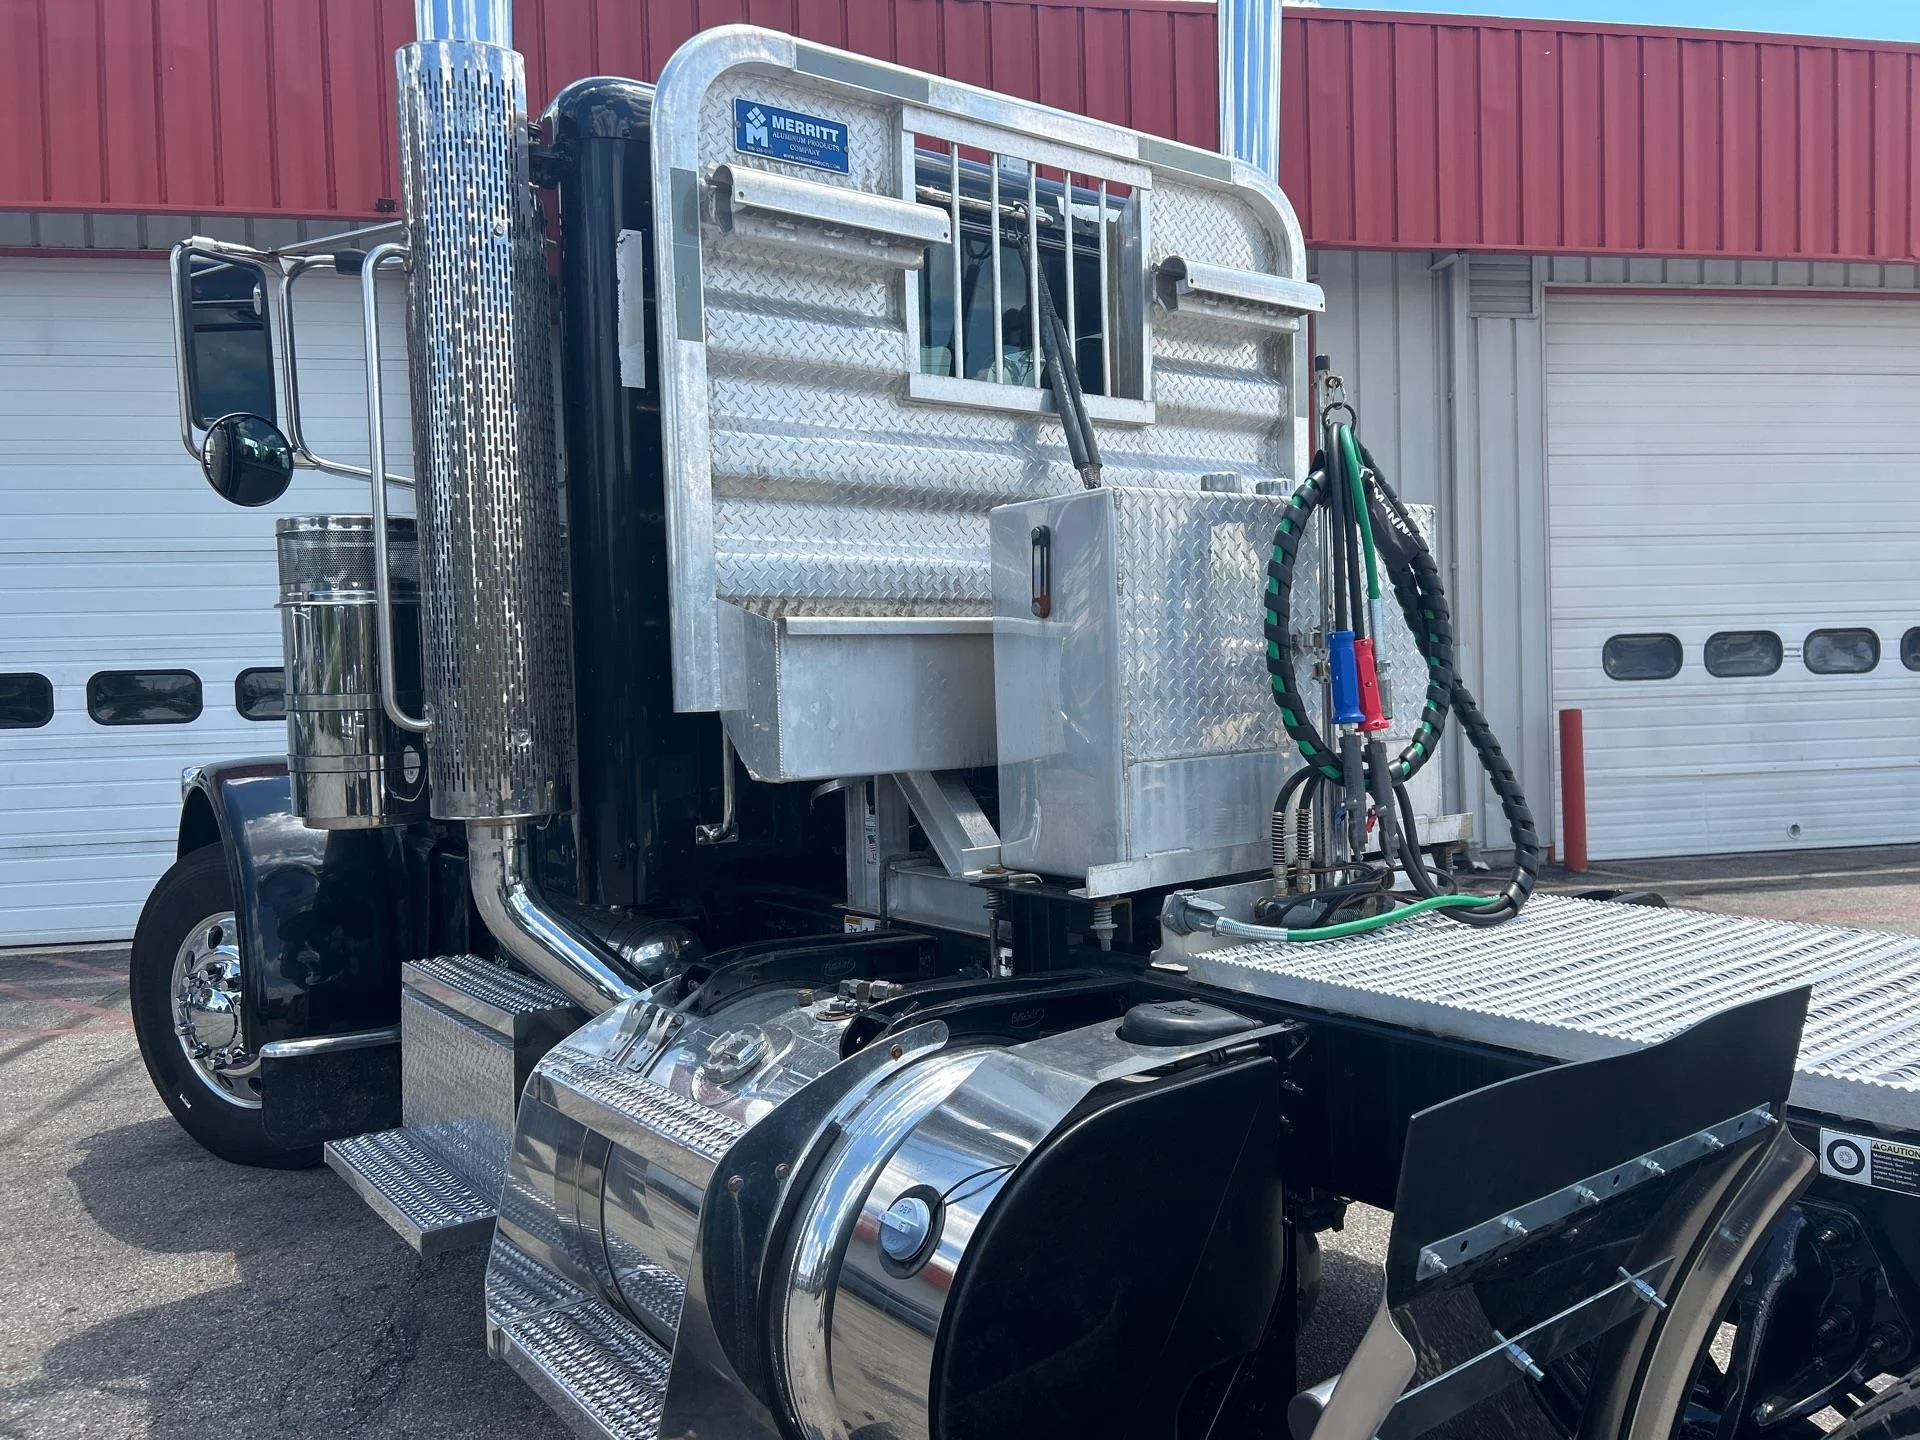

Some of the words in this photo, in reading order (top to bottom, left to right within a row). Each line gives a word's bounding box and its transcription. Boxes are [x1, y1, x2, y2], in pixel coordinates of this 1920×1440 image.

[772, 115, 839, 142] MERRITT
[772, 131, 806, 145] ALUMINUM
[807, 138, 840, 153] PRODUCTS
[789, 143, 821, 156] COMPANY
[1880, 1144, 1920, 1158] CAUTION
[899, 1204, 912, 1214] DEF
